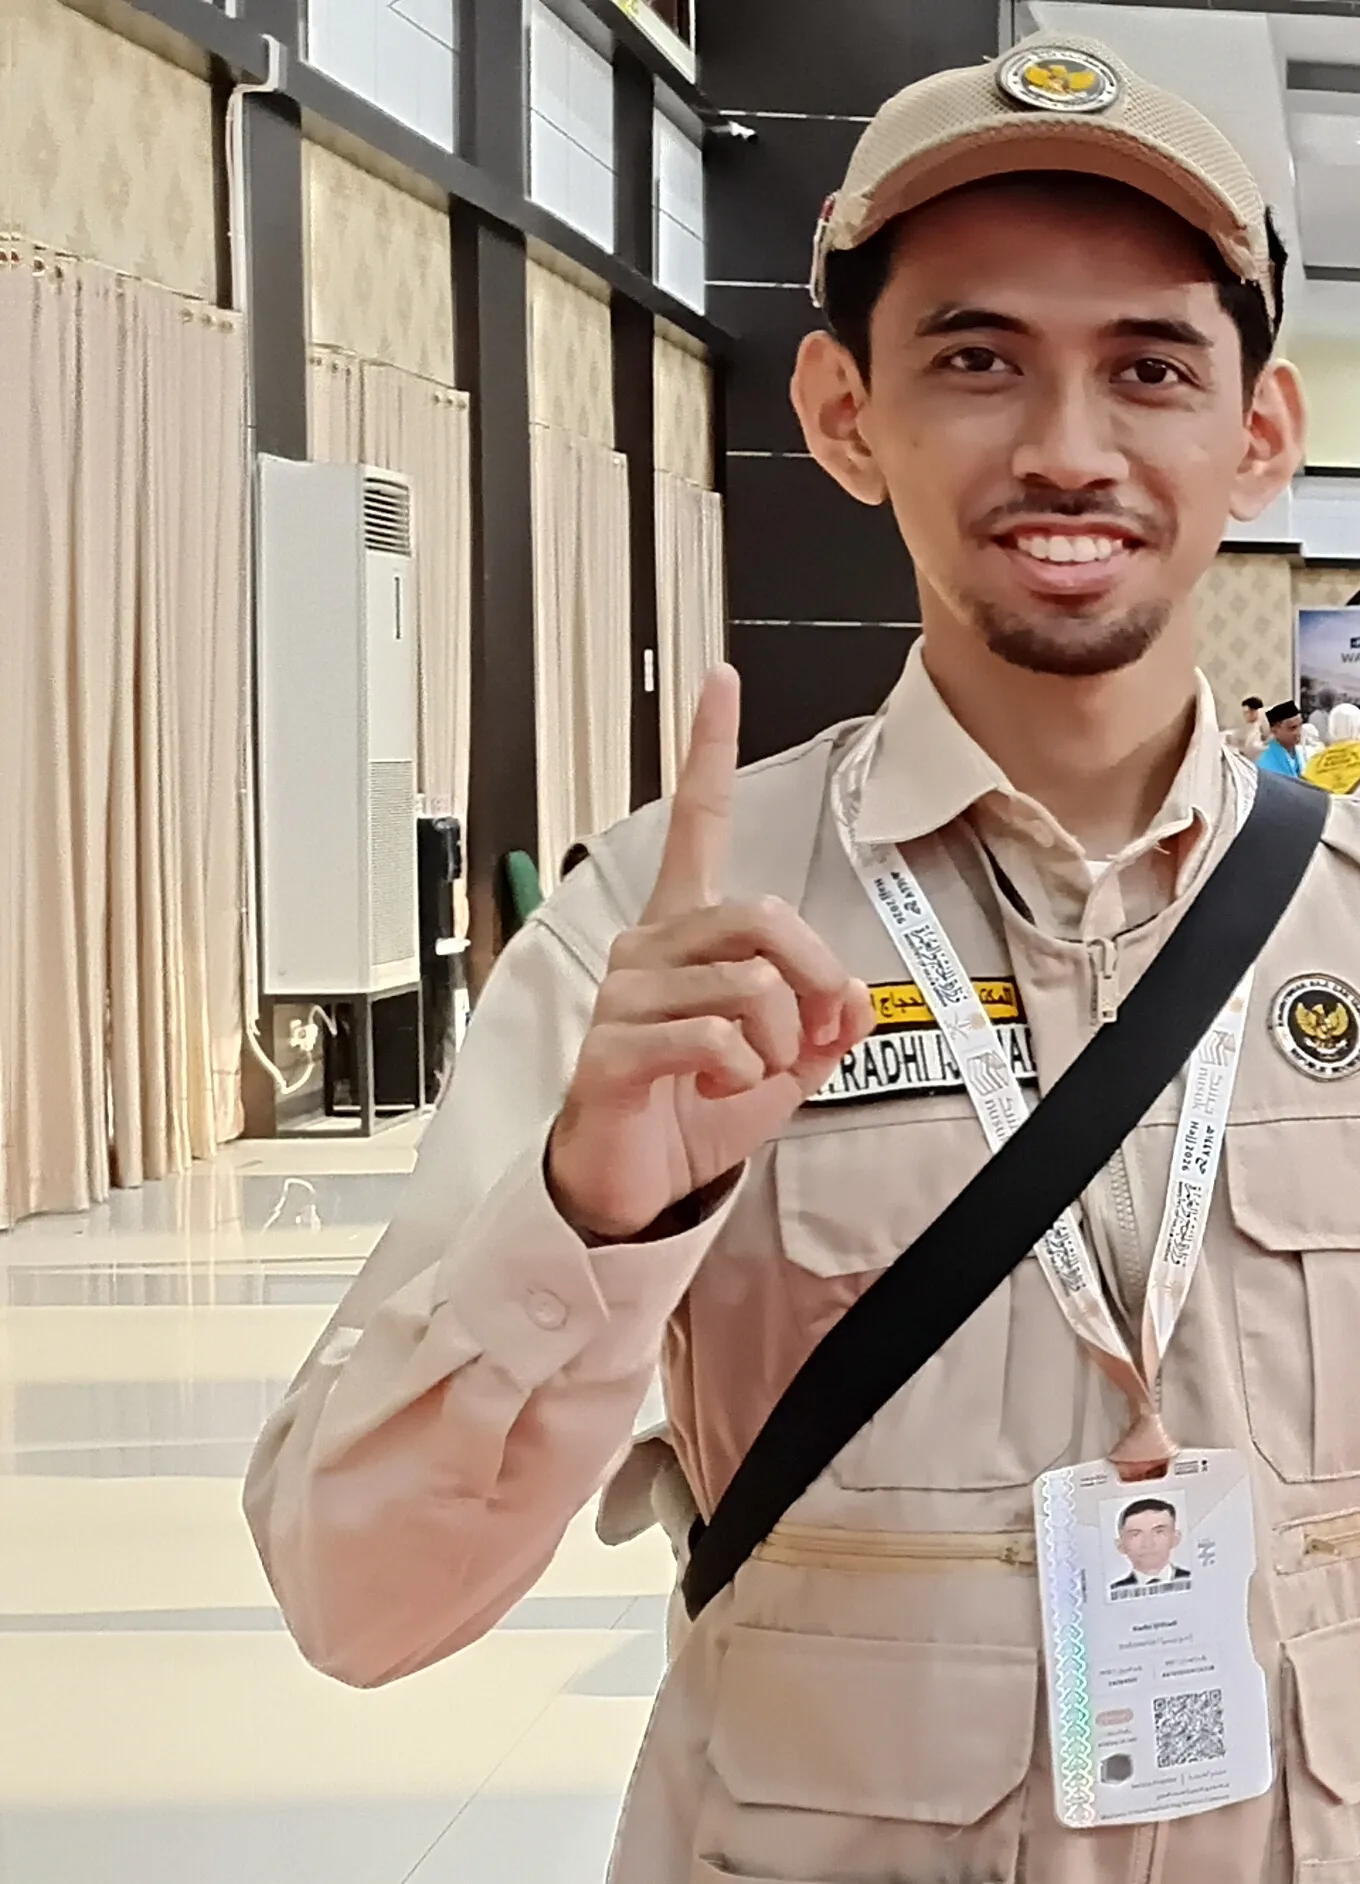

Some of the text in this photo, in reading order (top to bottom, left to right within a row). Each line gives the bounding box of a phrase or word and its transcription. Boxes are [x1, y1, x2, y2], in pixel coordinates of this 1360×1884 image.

[874, 878, 906, 924] Hajj 2026
[841, 1035, 930, 1092] RADHI
[1192, 1067, 1208, 1110] nusuk
[1181, 1121, 1200, 1171] Hajj 2026
